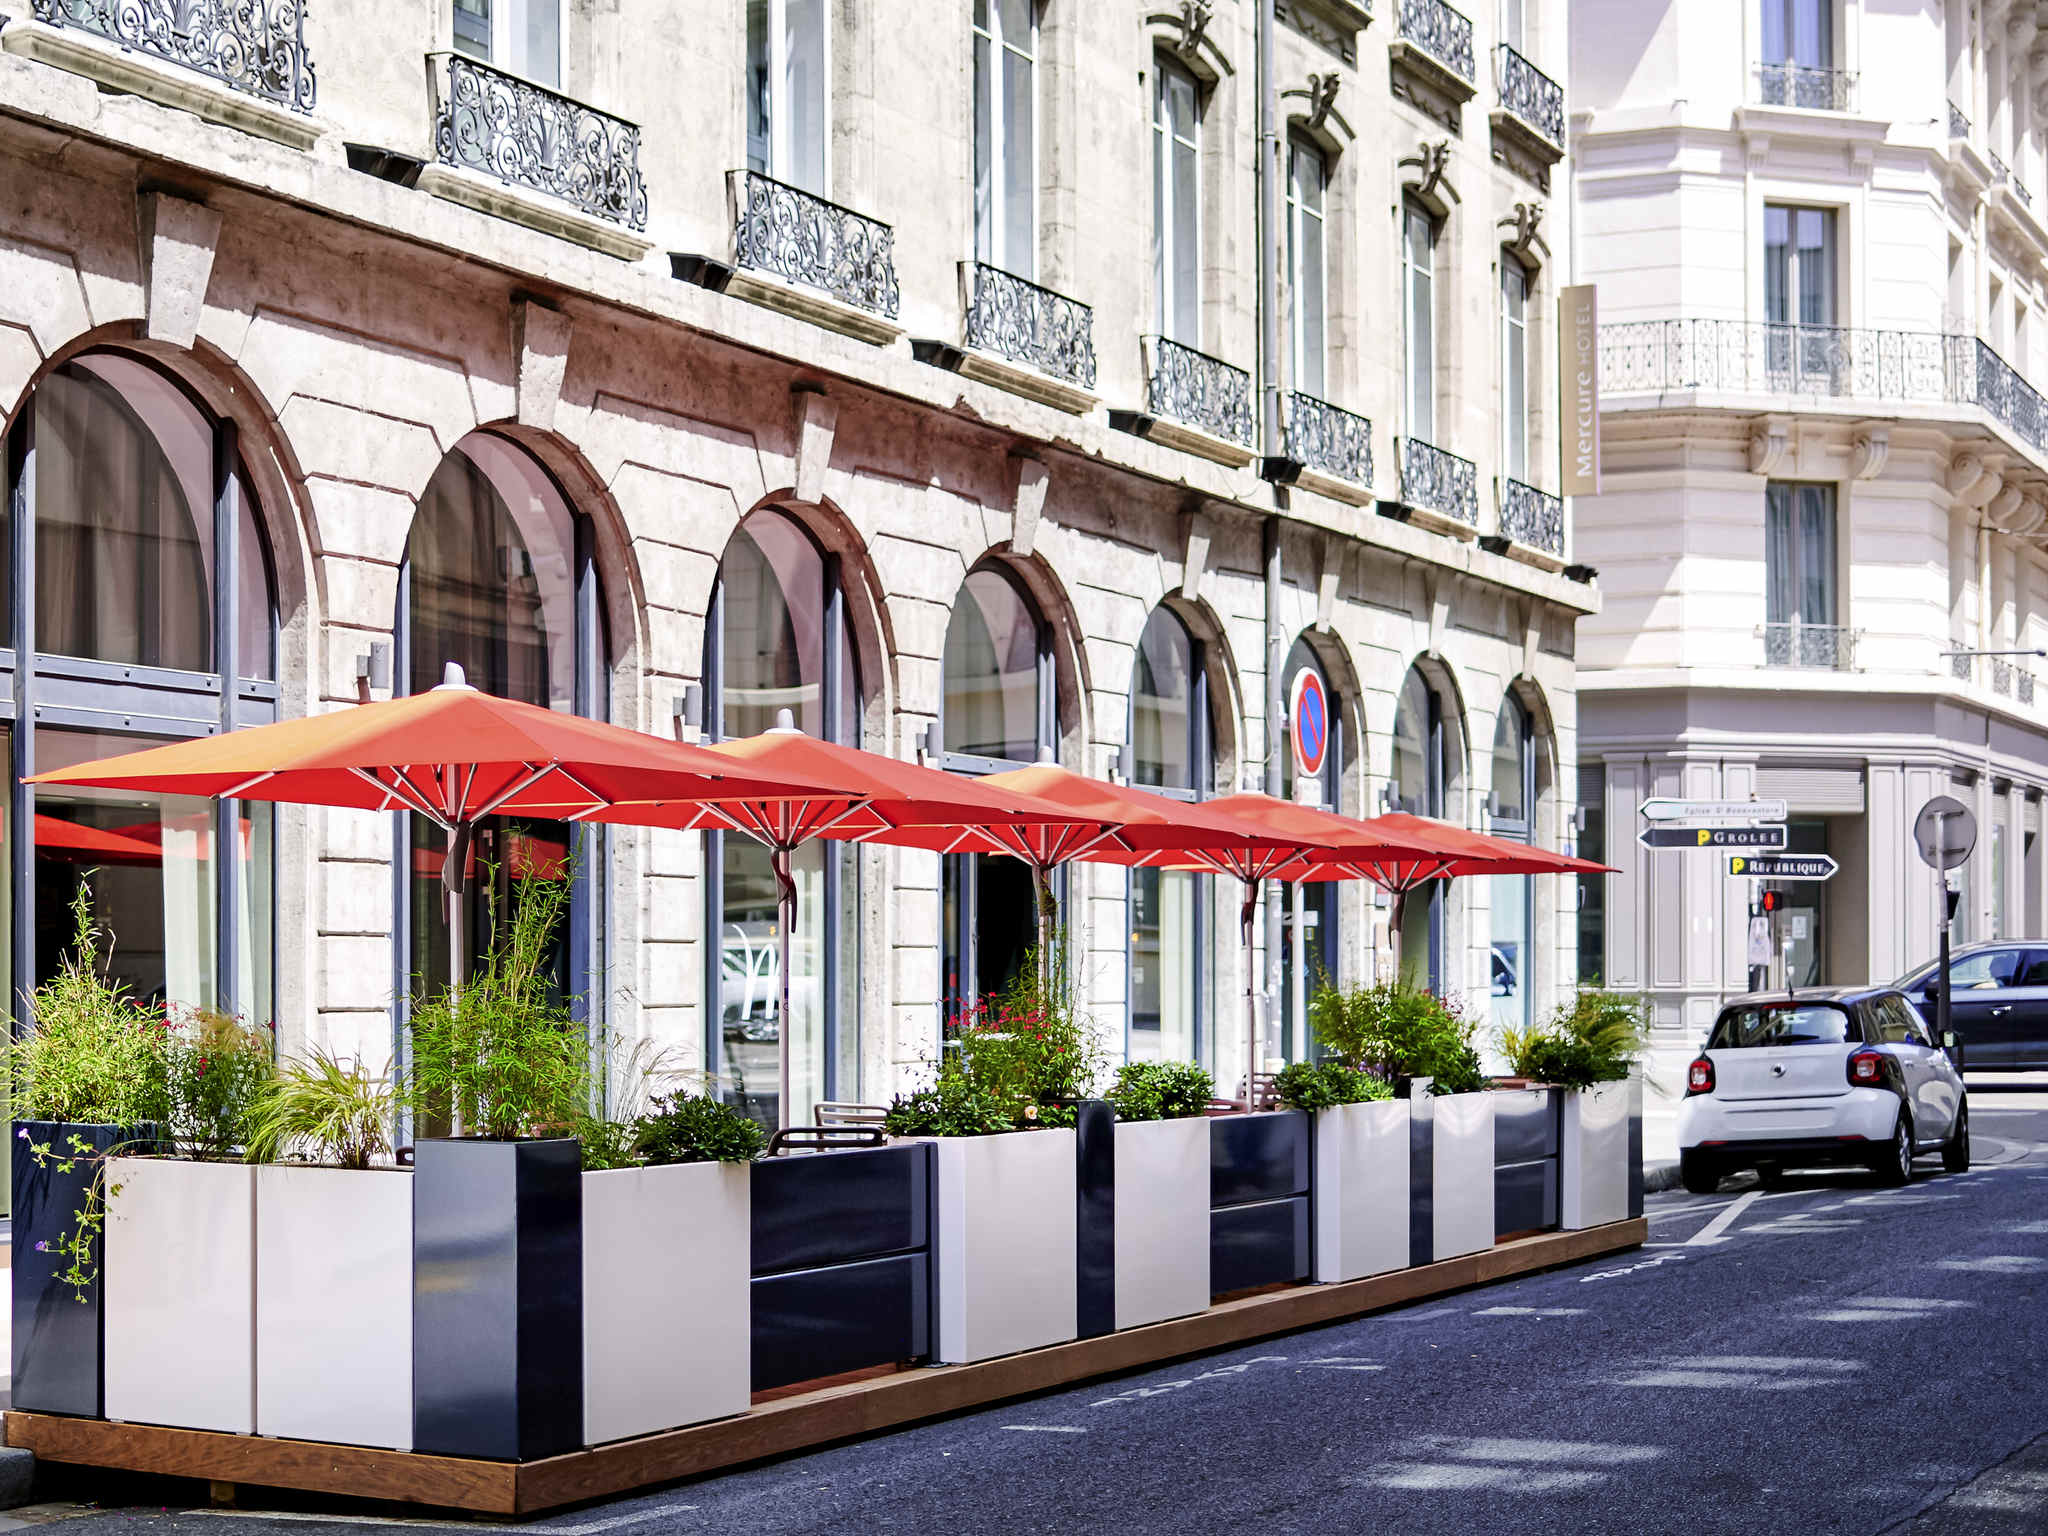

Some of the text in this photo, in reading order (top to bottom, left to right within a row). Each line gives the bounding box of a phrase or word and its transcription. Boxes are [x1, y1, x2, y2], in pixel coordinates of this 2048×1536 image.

[1575, 303, 1593, 478] Mercure HOTEL
[1697, 828, 1712, 846] P
[1732, 857, 1745, 875] P
